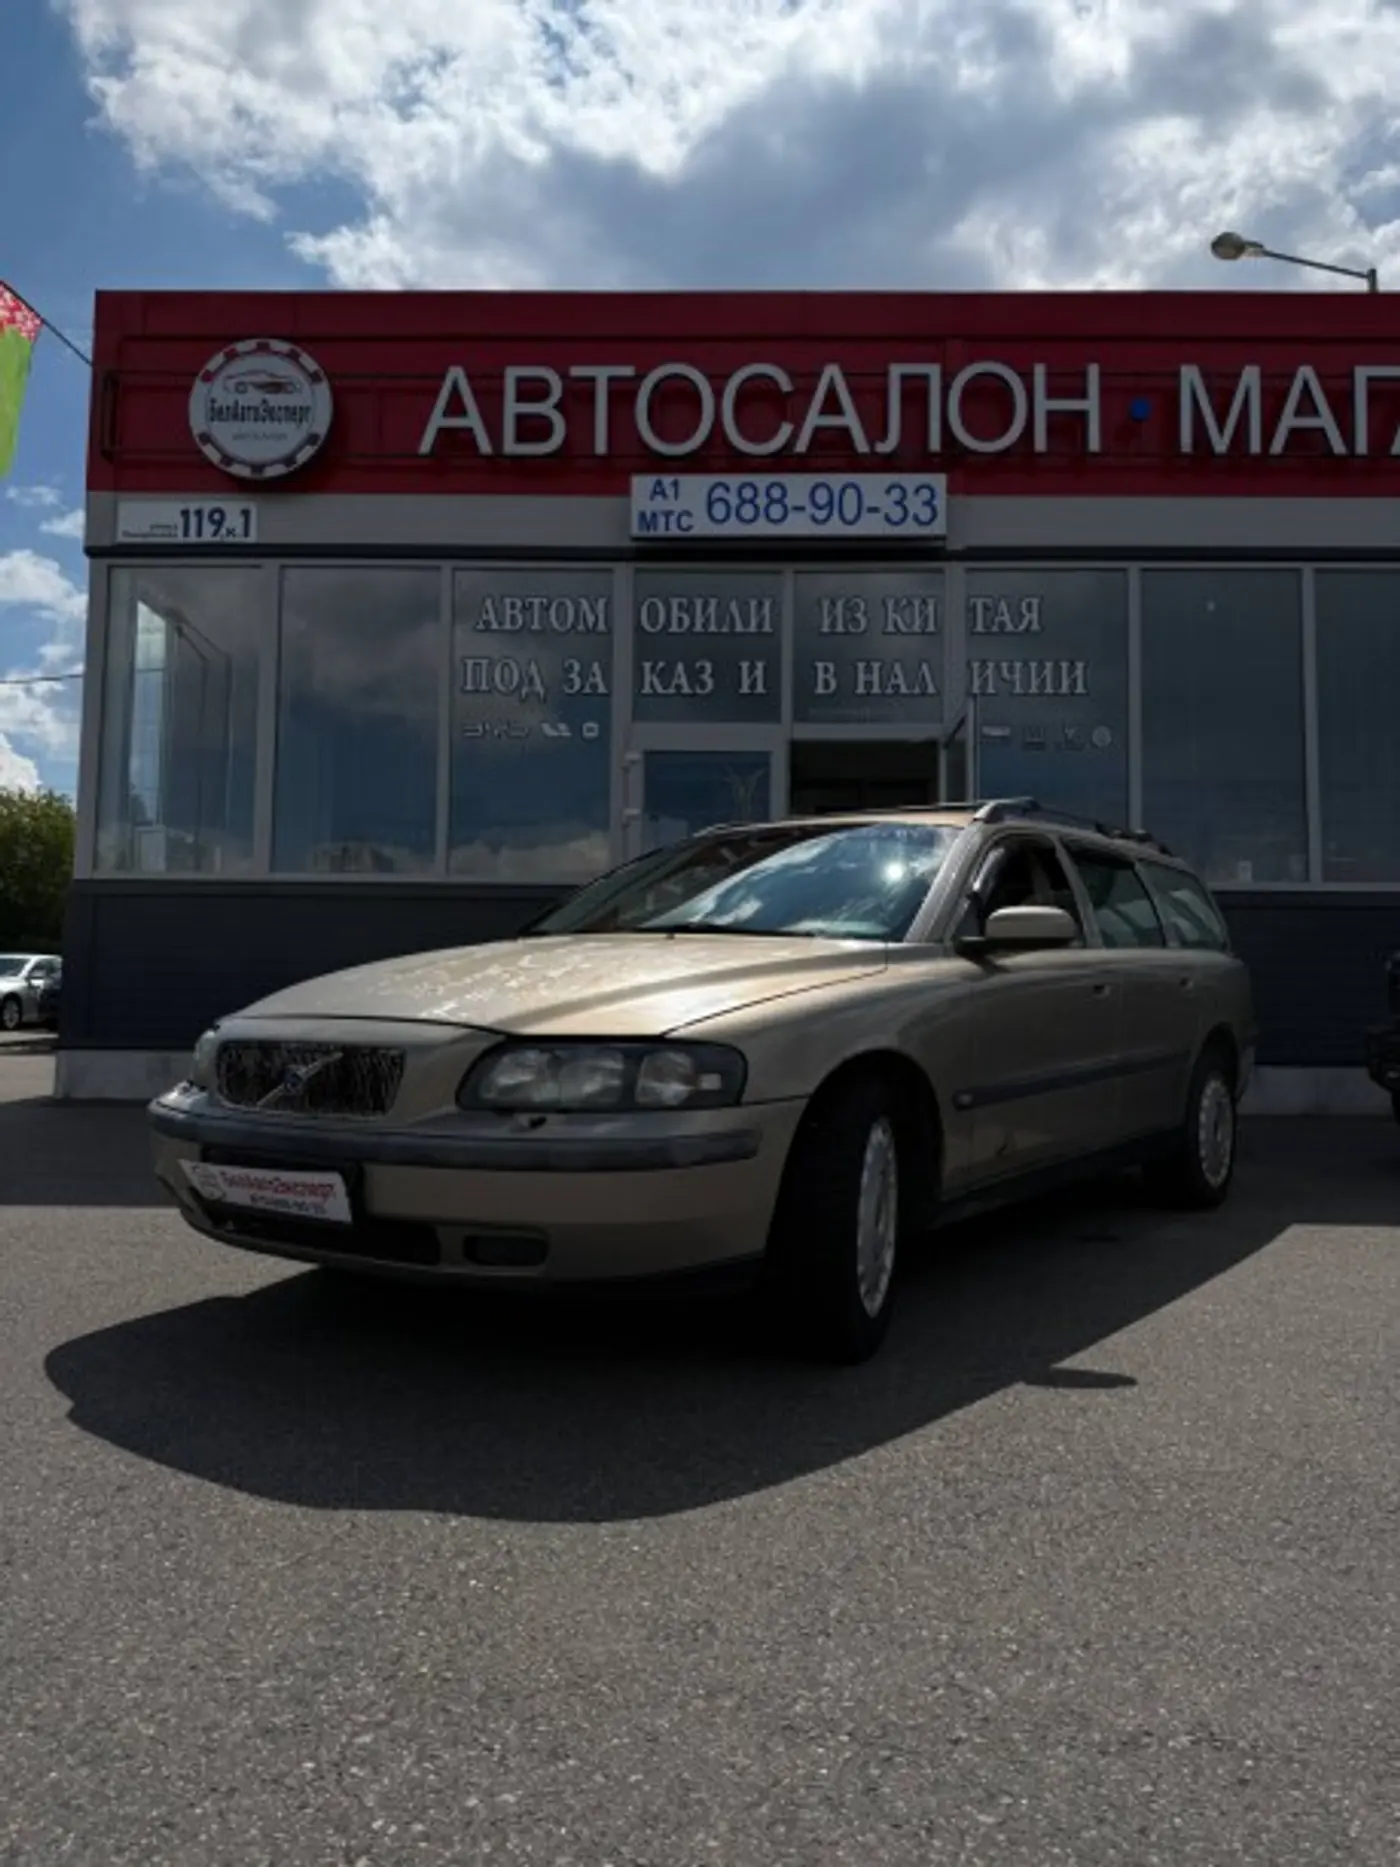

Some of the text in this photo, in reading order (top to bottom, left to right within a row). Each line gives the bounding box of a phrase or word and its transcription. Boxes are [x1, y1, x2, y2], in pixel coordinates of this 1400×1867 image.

[418, 362, 1400, 456] АВТОСАЛОН МАГ
[637, 509, 694, 533] МТС
[705, 481, 939, 527] 688-90-33
[819, 596, 868, 633] ИЗ
[462, 659, 546, 701] ПОД
[738, 659, 768, 695] И
[813, 659, 837, 695] В
